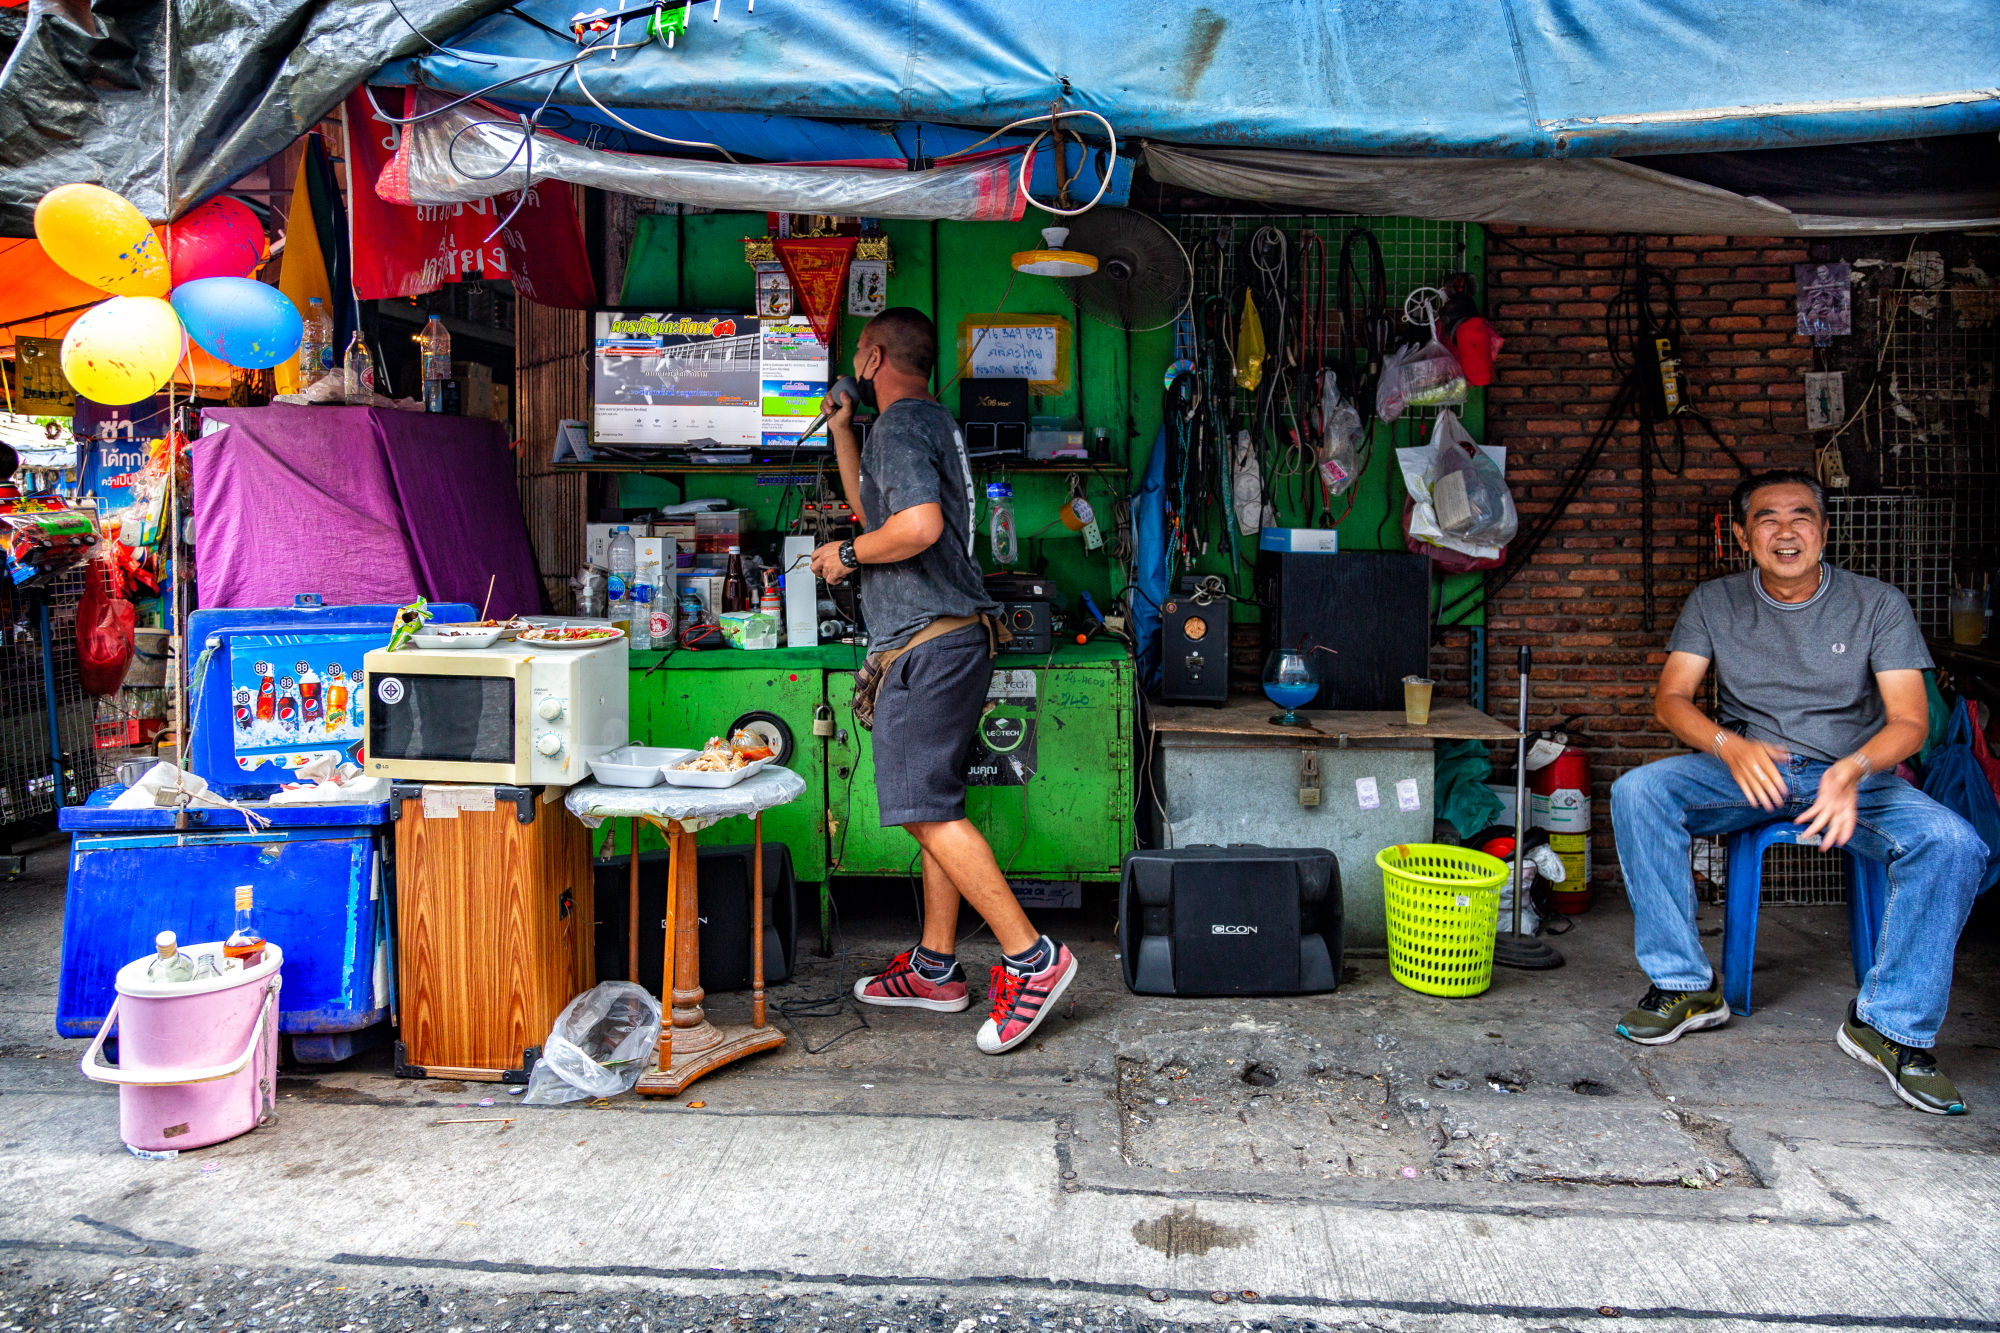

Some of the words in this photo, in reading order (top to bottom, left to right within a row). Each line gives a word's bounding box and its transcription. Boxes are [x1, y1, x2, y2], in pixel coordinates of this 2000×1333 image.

[976, 395, 997, 407] X96
[989, 680, 1029, 689] EOTECH
[986, 729, 1020, 737] LEOTECH
